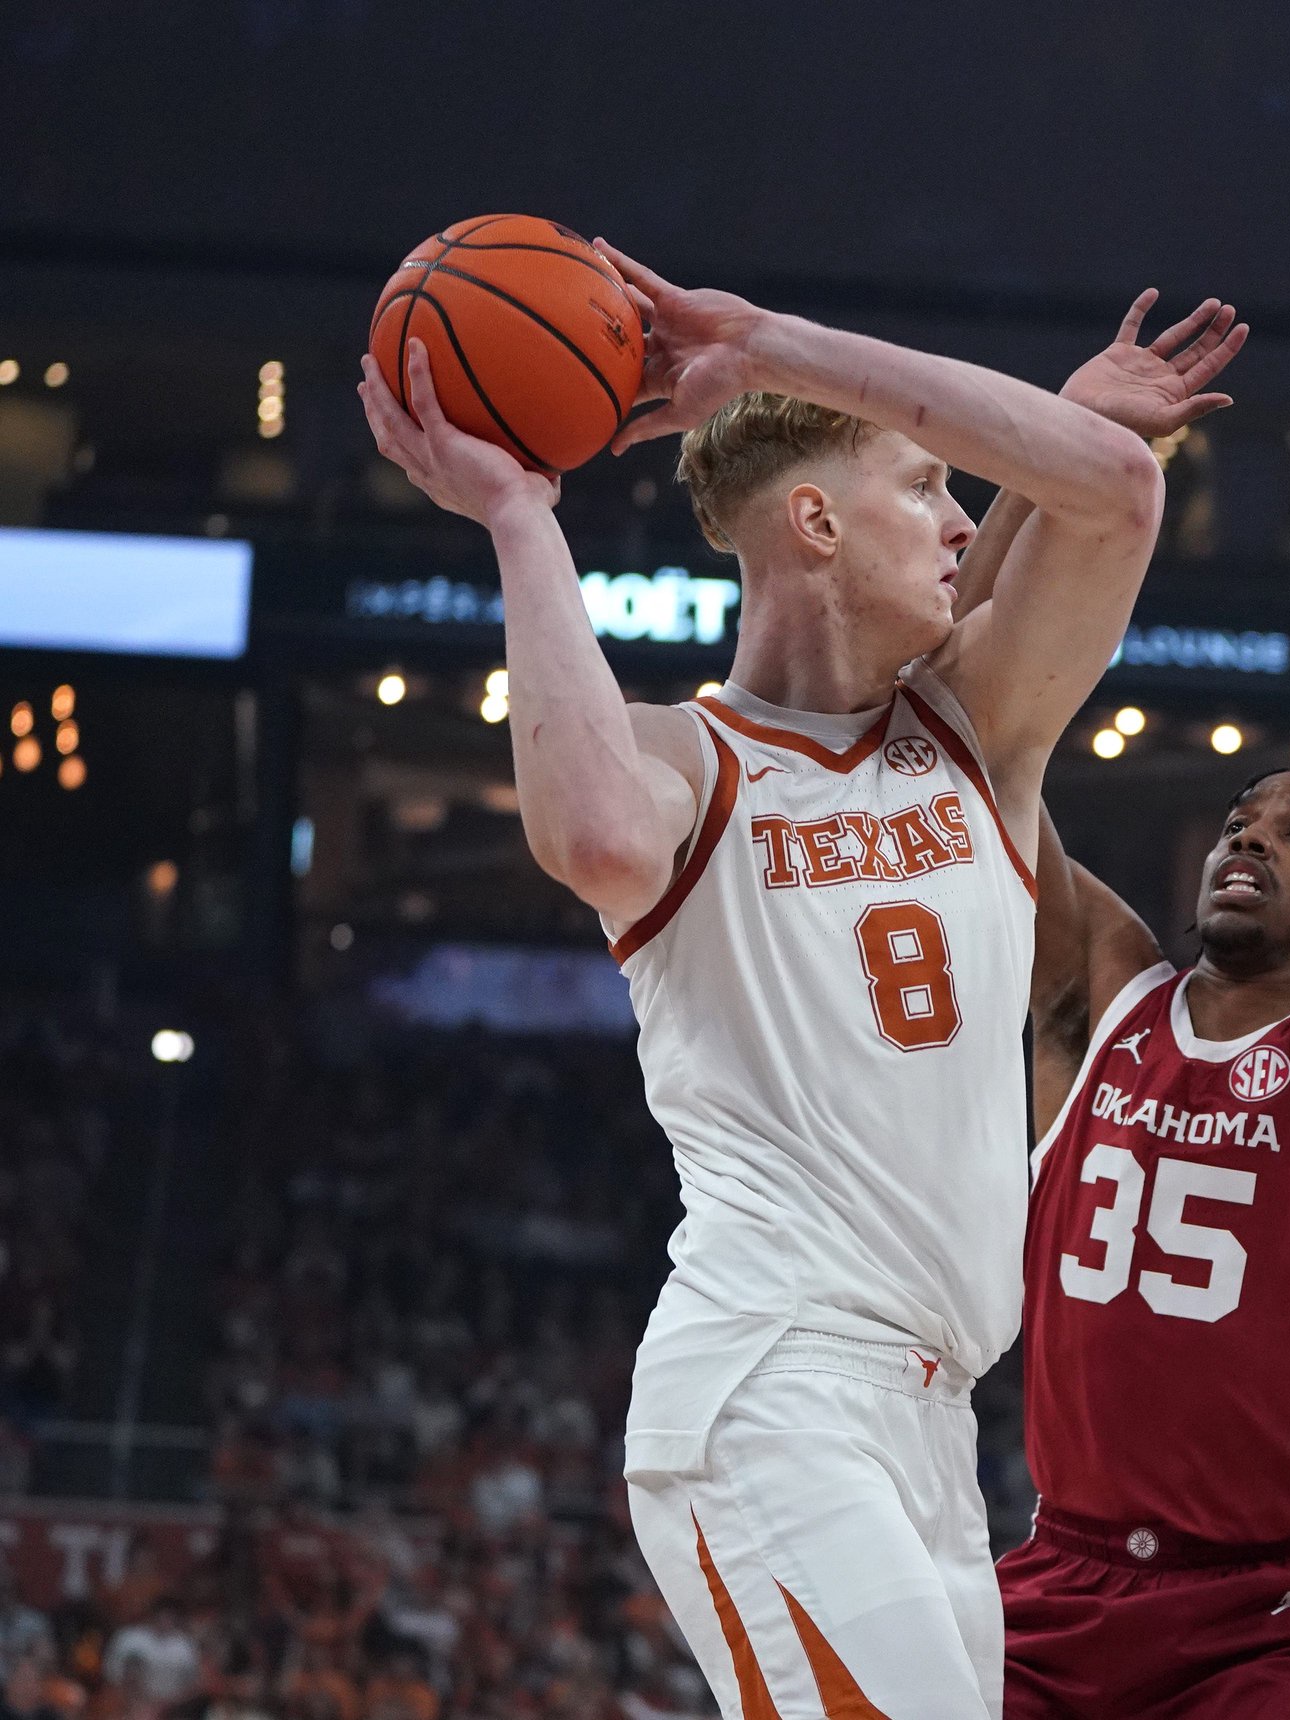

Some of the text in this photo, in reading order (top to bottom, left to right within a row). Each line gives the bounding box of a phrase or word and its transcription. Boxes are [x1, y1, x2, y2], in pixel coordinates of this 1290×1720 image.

[885, 738, 936, 776] SEC
[751, 791, 975, 889] TEXAS
[854, 899, 964, 1053] 8
[1233, 1048, 1288, 1099] SEC
[1091, 1082, 1281, 1153] OKAHOMA
[1059, 1143, 1258, 1323] 35
